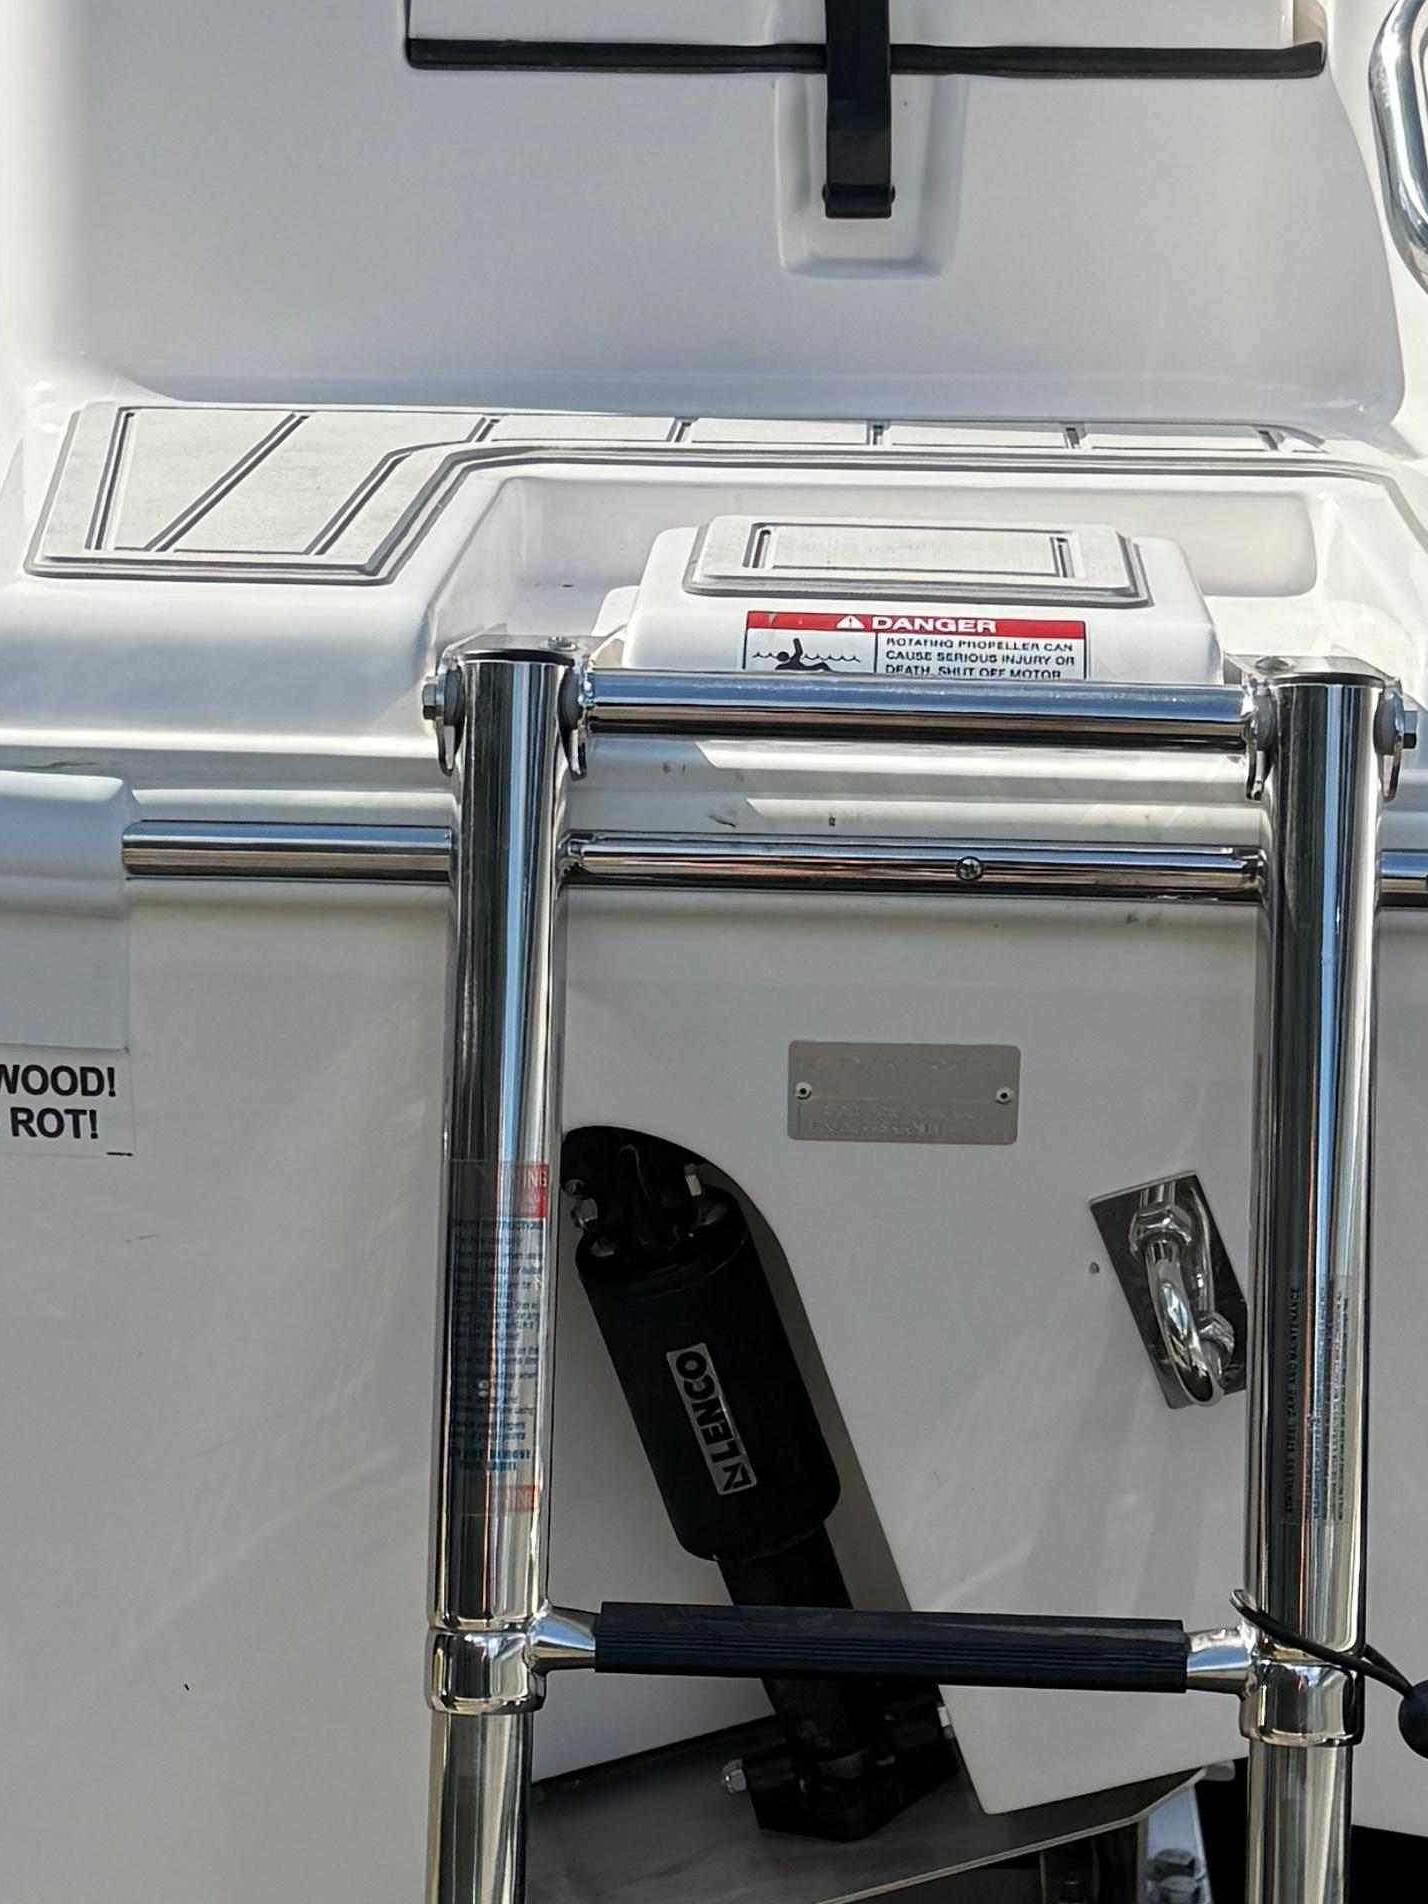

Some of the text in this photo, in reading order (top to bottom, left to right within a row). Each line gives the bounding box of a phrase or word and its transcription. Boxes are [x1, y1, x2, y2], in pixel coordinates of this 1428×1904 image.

[872, 616, 997, 633] DANGER
[886, 637, 1073, 652] ROTATING PROPELLER CAN
[885, 650, 1075, 666] CAUSE SERIOUS INJURY OR
[938, 666, 976, 677] SHUT
[979, 667, 1006, 678] OFF
[1009, 668, 1062, 679] MOTOR
[10, 1106, 98, 1139] ROT!
[676, 1351, 740, 1463] LENCO
